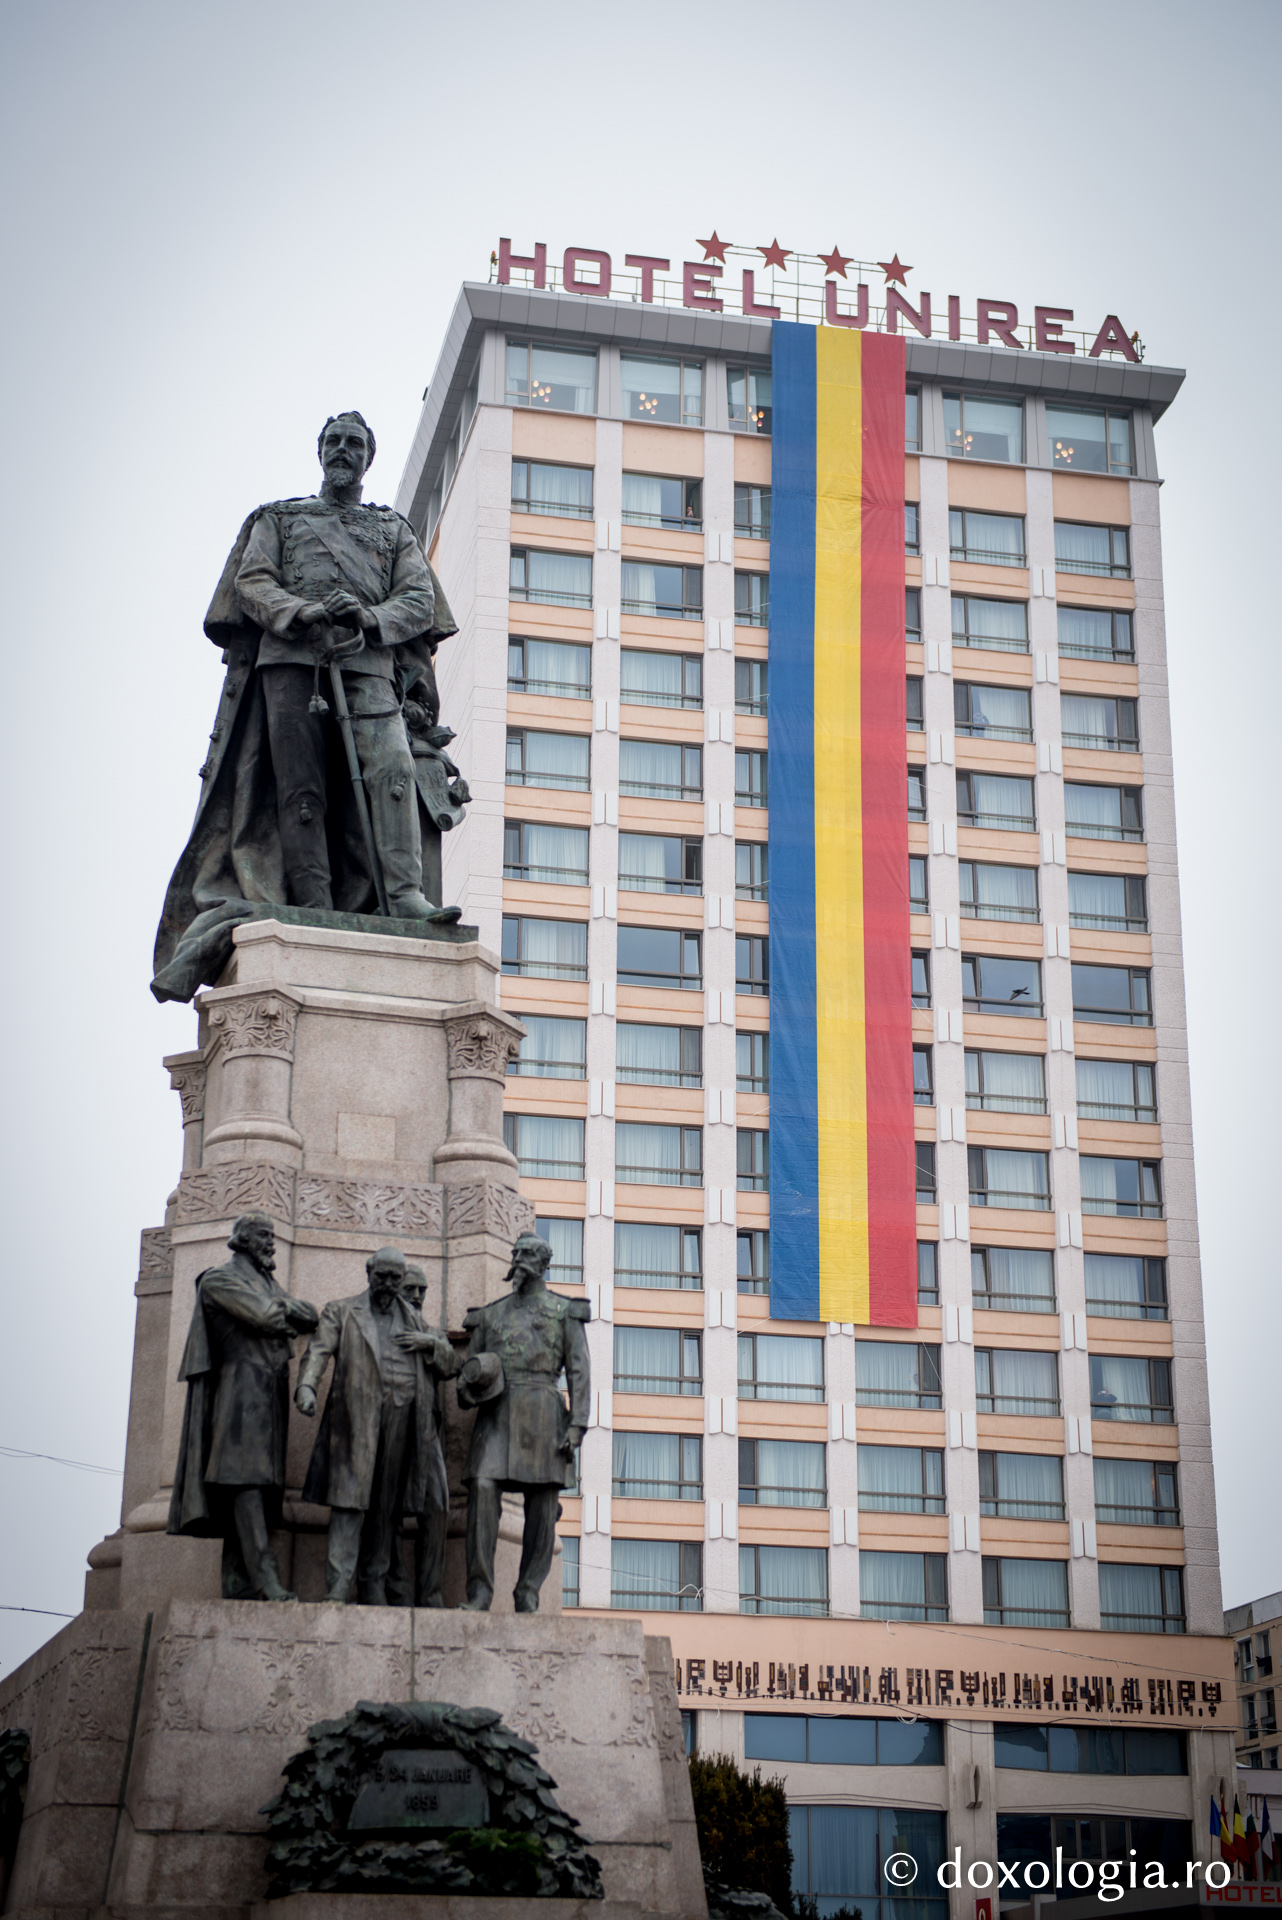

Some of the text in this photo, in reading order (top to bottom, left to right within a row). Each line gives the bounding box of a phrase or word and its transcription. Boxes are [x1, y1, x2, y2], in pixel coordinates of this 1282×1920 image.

[498, 237, 1140, 362] HOTEL UNIREA
[405, 1794, 439, 1811] 1859
